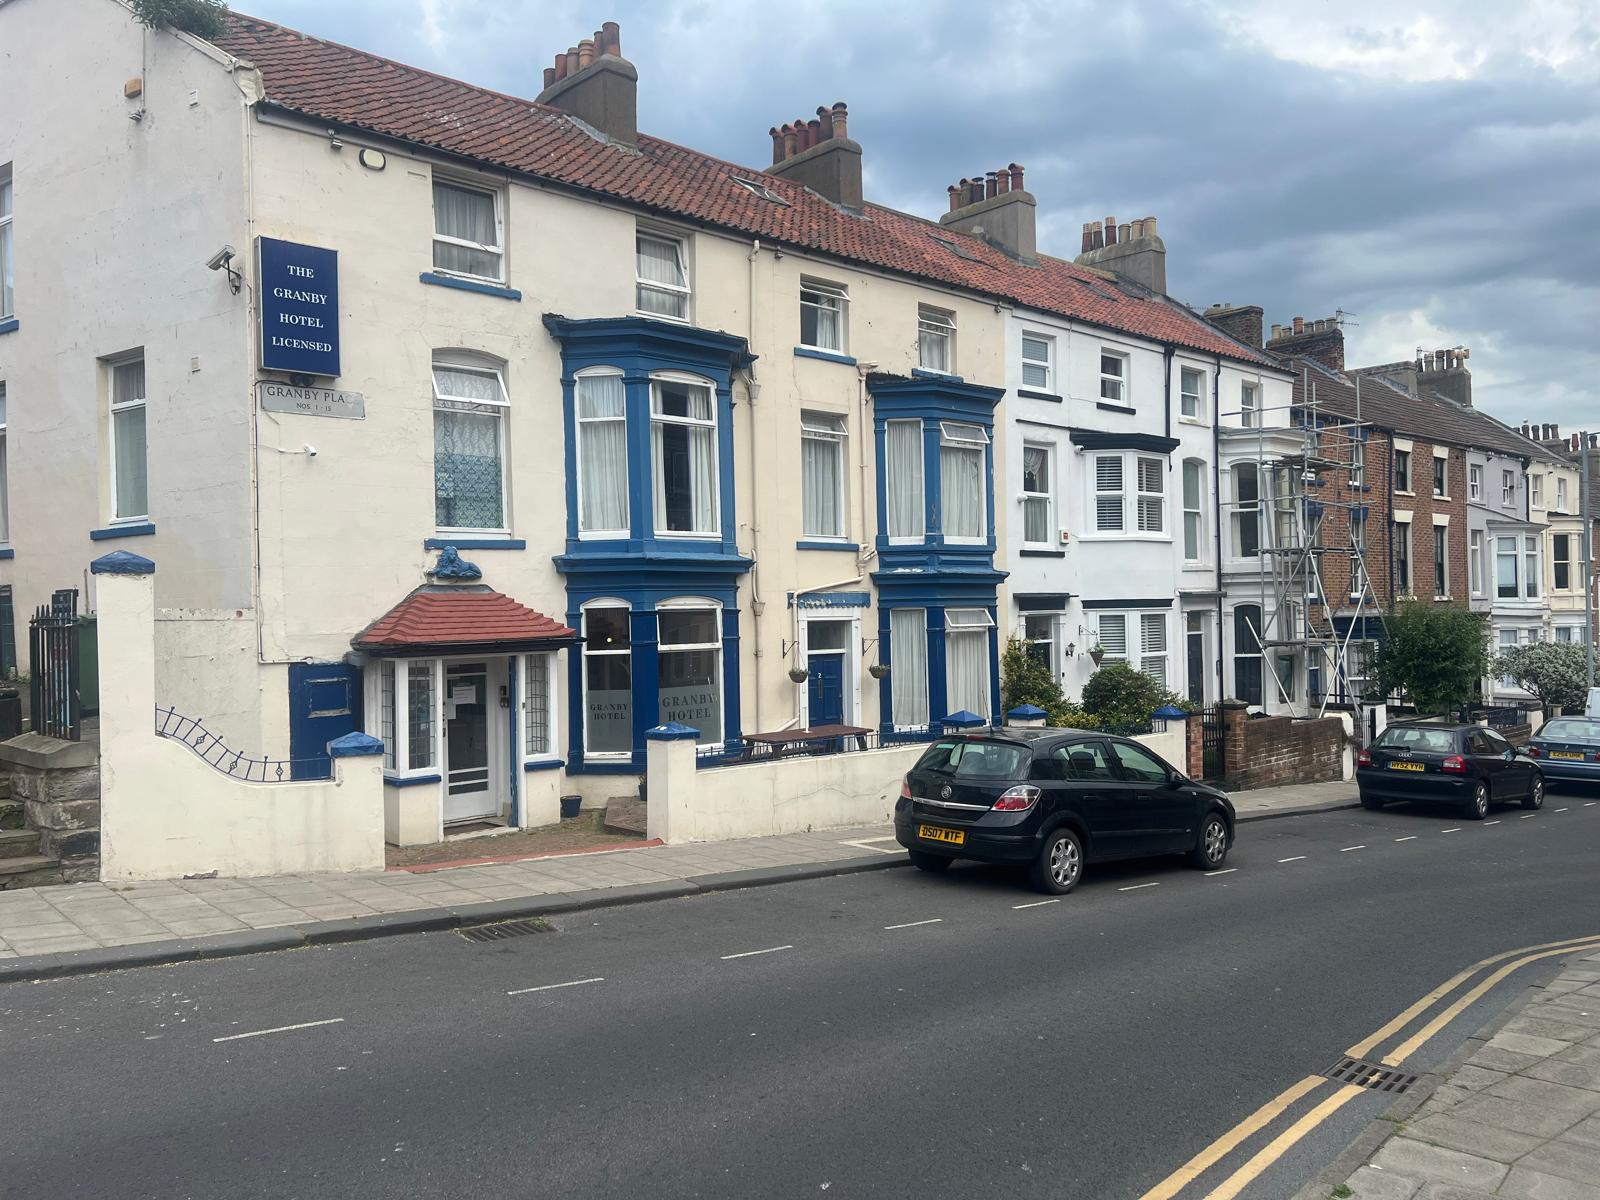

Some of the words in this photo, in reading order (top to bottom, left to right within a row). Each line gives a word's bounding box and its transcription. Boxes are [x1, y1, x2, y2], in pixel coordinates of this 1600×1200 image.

[287, 265, 314, 279] THE
[273, 287, 328, 305] GRANBY
[279, 312, 324, 329] HOTEL
[271, 336, 332, 353] LICENSED
[266, 386, 319, 401] GRANBY
[324, 392, 351, 404] PLA
[590, 703, 628, 711] GRANBY
[662, 693, 715, 708] GRANBY
[594, 712, 626, 721] HOTEL
[668, 707, 711, 722] HOTEL
[922, 827, 943, 838] DS07
[944, 830, 962, 841] WTF
